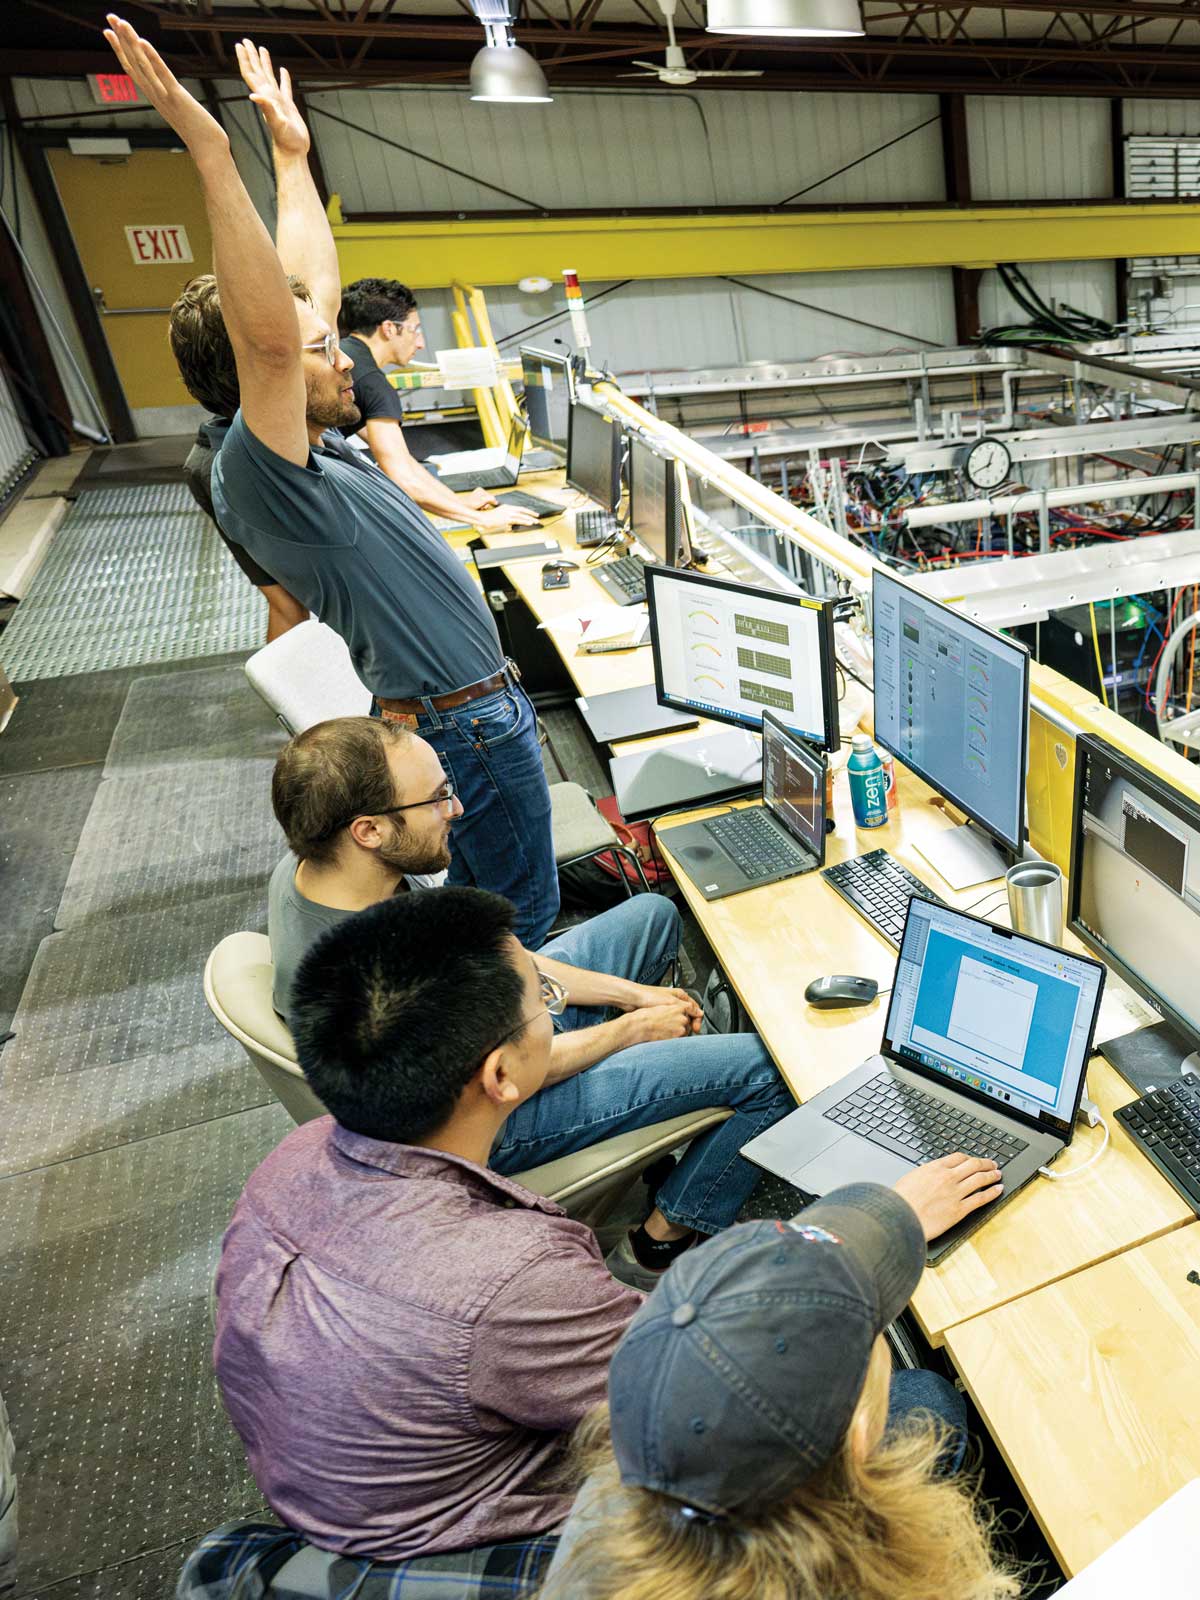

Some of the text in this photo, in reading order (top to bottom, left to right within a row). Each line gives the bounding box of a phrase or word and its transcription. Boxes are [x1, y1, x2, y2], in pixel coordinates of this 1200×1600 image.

[97, 74, 138, 102] EXIT
[133, 229, 183, 260] EXIT
[865, 775, 880, 808] zen
